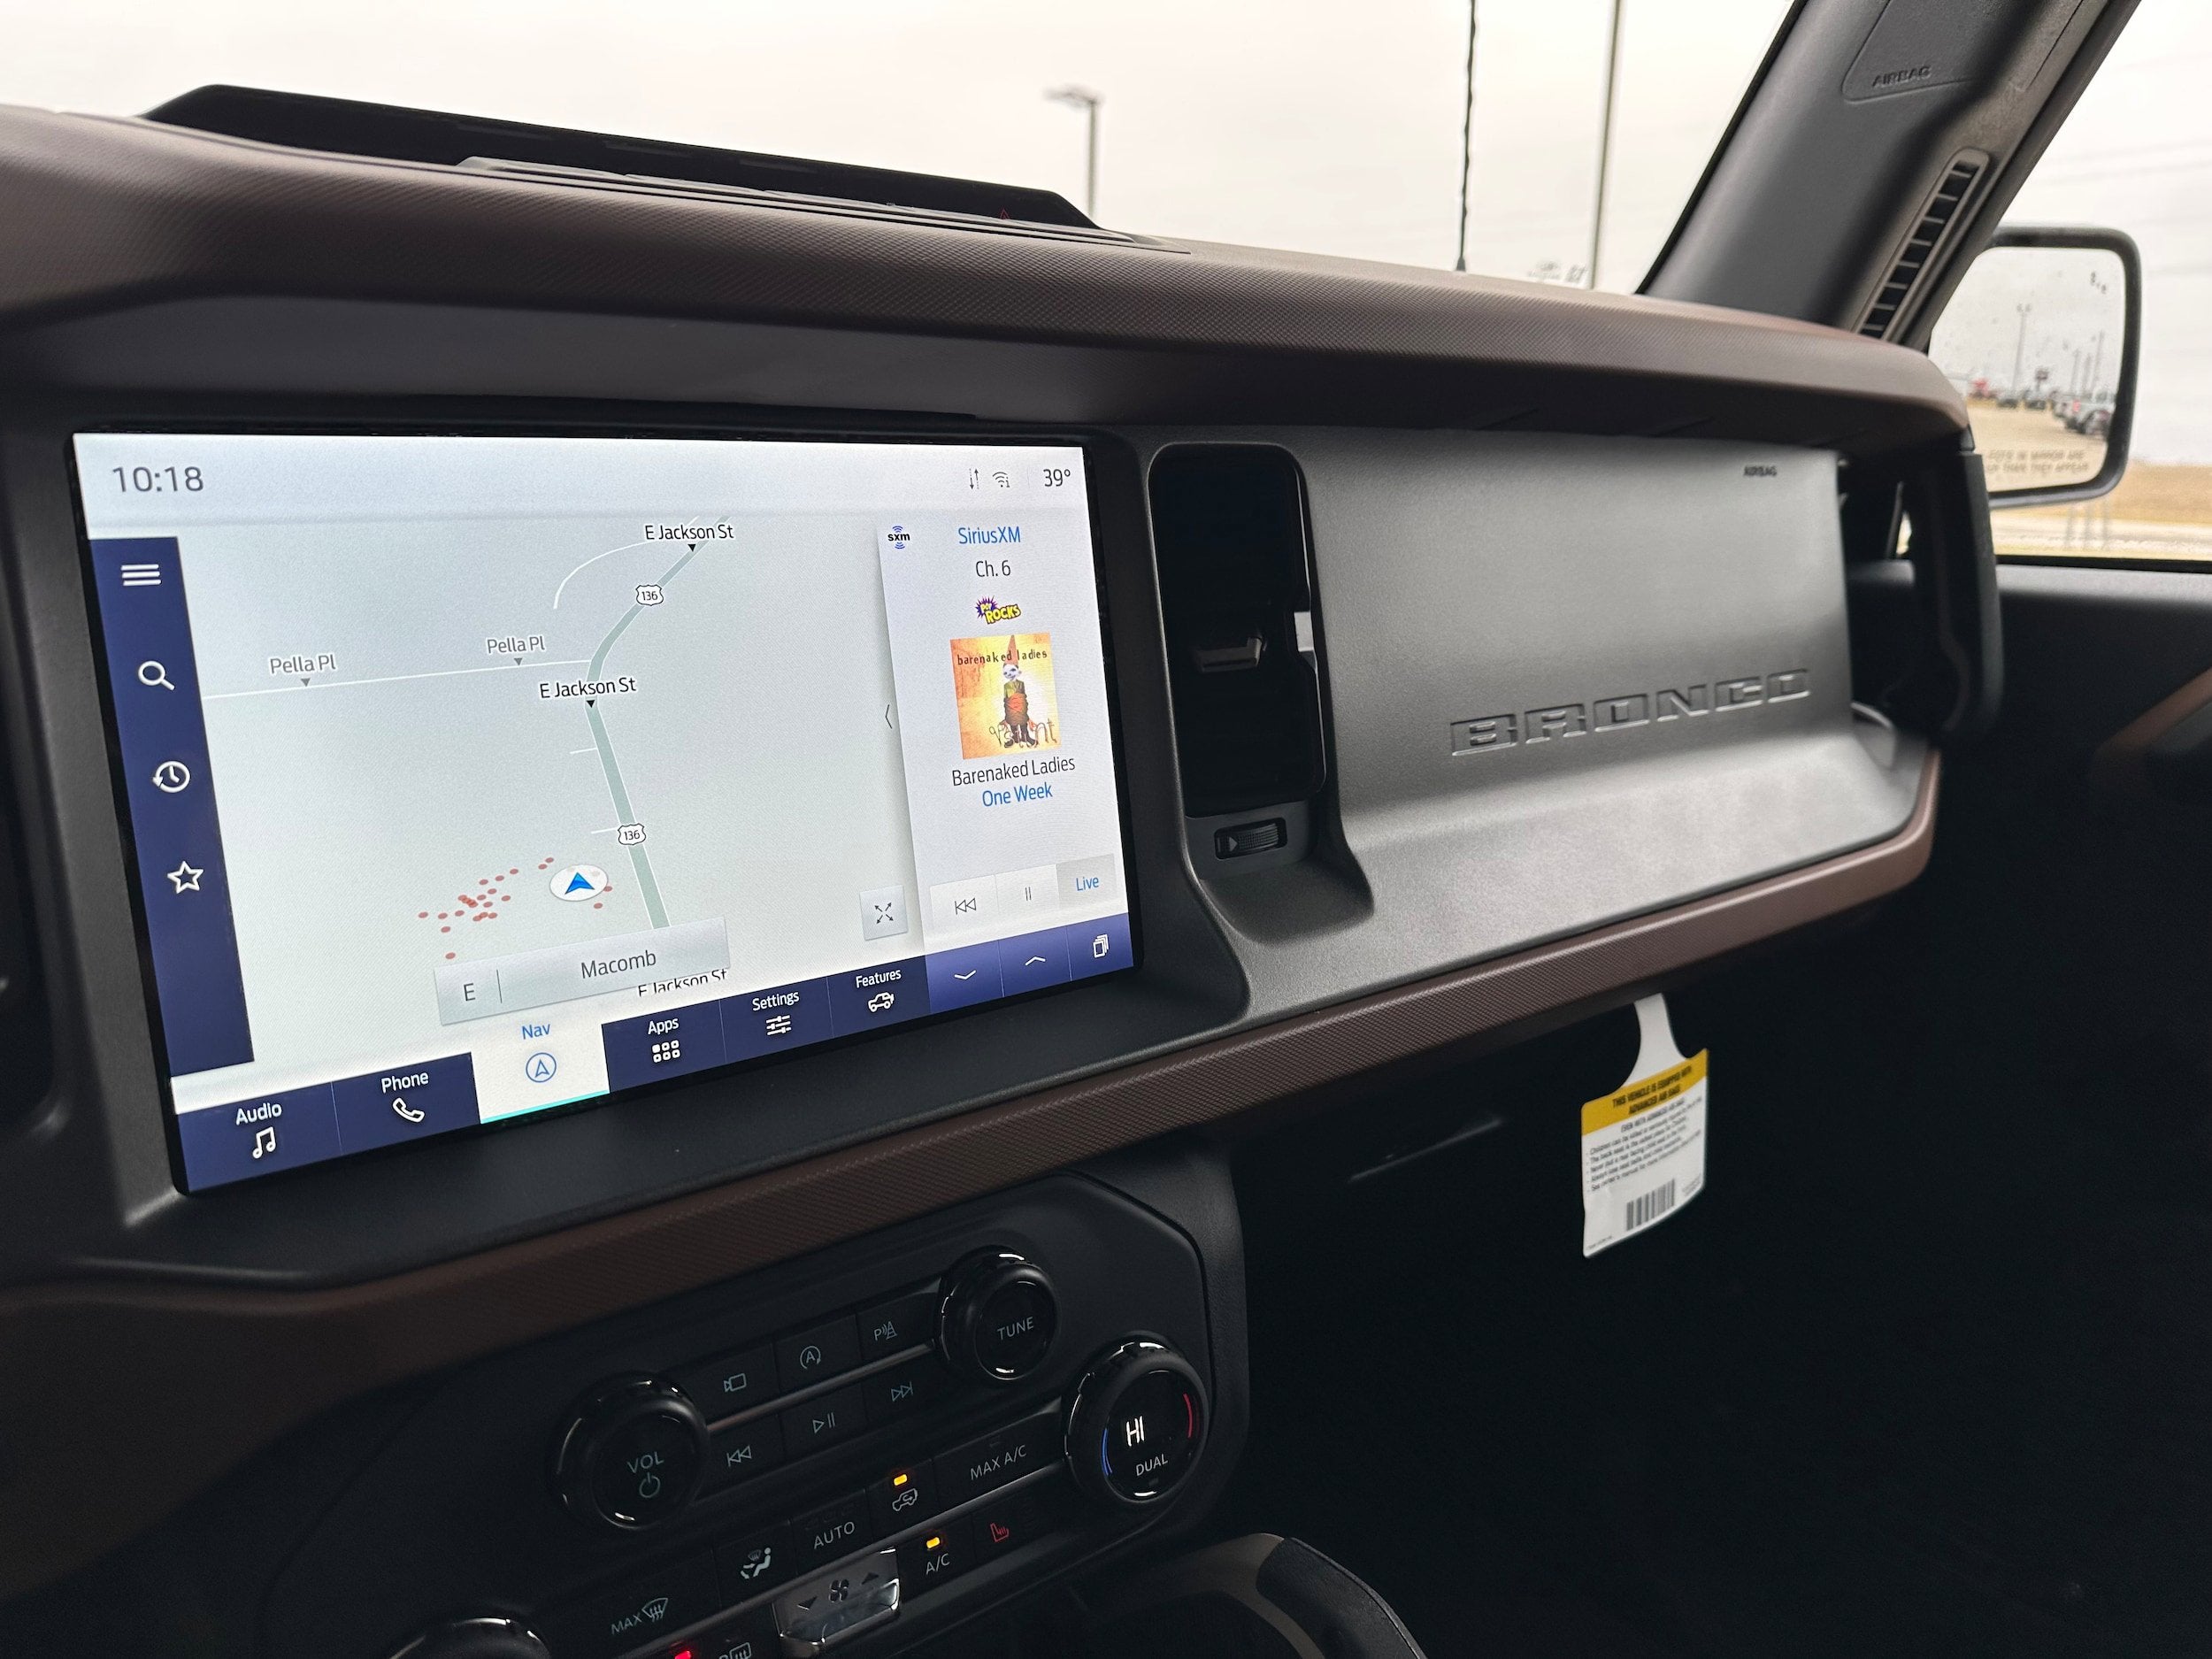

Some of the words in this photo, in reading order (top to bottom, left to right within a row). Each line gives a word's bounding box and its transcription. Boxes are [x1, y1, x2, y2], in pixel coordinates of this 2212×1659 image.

[1871, 65, 1932, 88] AIRBAG
[111, 465, 204, 493] 10:18
[1743, 465, 1778, 477] AIRBAG
[645, 526, 655, 541] E
[657, 524, 716, 541] Jackson
[718, 524, 734, 540] St
[958, 526, 1021, 544] SiriusXM
[975, 559, 998, 577] Ch.
[1002, 559, 1011, 576] 6
[641, 589, 658, 603] 136
[985, 604, 1021, 625] ROCKS
[487, 638, 526, 655] Pella
[529, 635, 546, 651] Pl
[269, 657, 314, 673] Pella
[318, 654, 336, 672] Pl
[957, 650, 1012, 665] barenaked
[1017, 649, 1048, 661] ladies
[540, 683, 550, 698] E
[553, 680, 616, 699] Jackson
[618, 678, 637, 693] St
[1450, 668, 1810, 756] BRONCO
[951, 762, 1029, 787] Barenaked
[1031, 755, 1076, 780] Ladies
[981, 787, 1011, 807] One
[1013, 782, 1053, 803] Week
[623, 828, 641, 842] 136
[1075, 873, 1100, 892] Live
[463, 983, 476, 1002] E
[580, 949, 657, 979] Macomb
[855, 967, 902, 988] Features
[752, 990, 800, 1012] Settings
[522, 1023, 551, 1040] Nav
[647, 1018, 680, 1035] Apps
[381, 1070, 430, 1092] Phone
[234, 1101, 282, 1125] Audio
[996, 1317, 1035, 1341] TUNE
[1125, 1417, 1145, 1448] HI
[627, 1451, 664, 1474] VOL
[970, 1456, 1001, 1481] MAX
[1004, 1444, 1027, 1467] A/C
[1135, 1453, 1169, 1478] DUAL
[812, 1520, 856, 1548] AUTO
[925, 1552, 951, 1576] A/C
[611, 1613, 642, 1635] MAX
